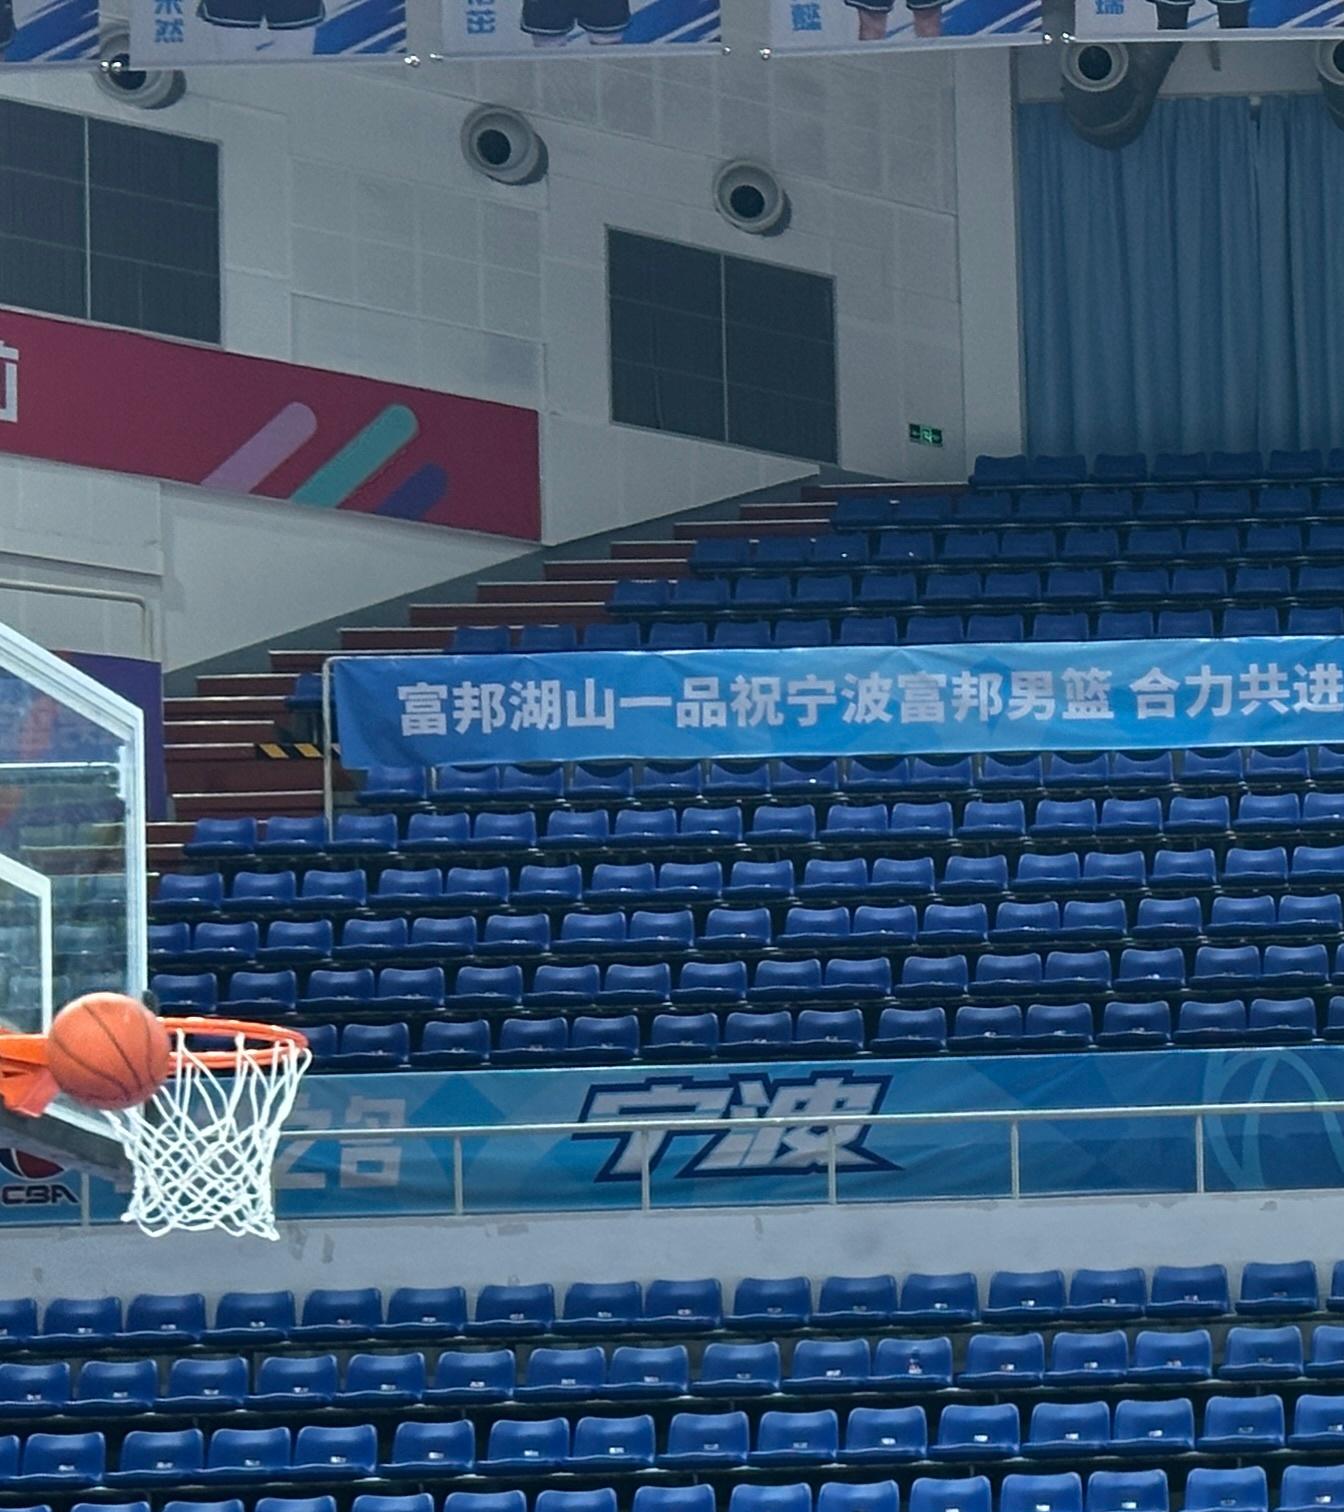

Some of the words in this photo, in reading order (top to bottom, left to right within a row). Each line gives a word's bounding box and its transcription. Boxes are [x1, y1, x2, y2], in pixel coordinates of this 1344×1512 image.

[397, 666, 1114, 737] 富邦湖山一品祝宁波富邦男篮
[1129, 661, 1344, 719] 合力共进
[573, 1071, 898, 1182] 宁波
[1, 1183, 79, 1205] CBA
